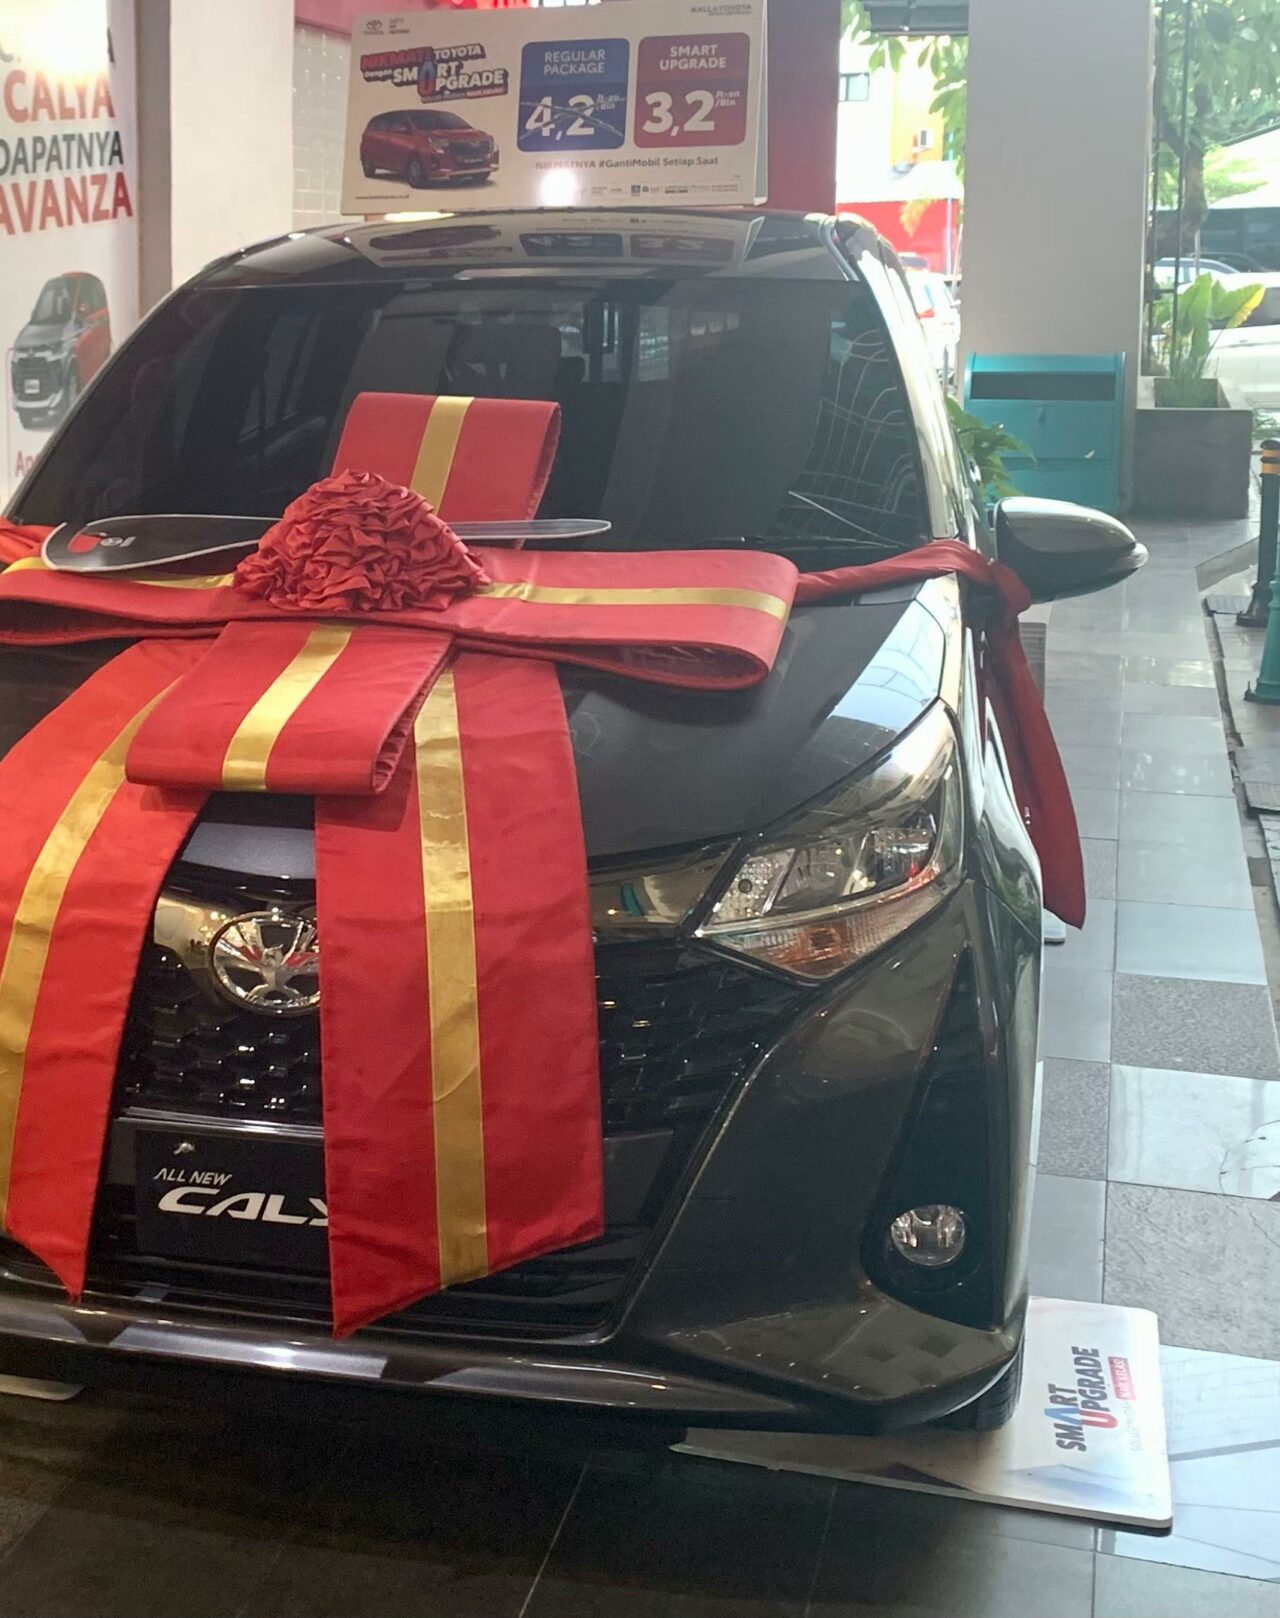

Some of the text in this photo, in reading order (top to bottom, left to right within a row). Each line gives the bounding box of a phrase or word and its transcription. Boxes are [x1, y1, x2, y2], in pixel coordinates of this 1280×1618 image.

[434, 45, 482, 60] TOYOTA
[544, 50, 606, 63] REGULAR
[670, 45, 718, 57] SMART
[543, 62, 606, 76] PACKAGE
[659, 57, 727, 70] UPGRADE
[642, 90, 716, 137] 3,2
[598, 157, 660, 169] #GantiMobil
[663, 157, 695, 169] Setiap
[697, 156, 719, 166] Saat
[153, 1167, 233, 1185] ALL NEW
[158, 1186, 329, 1227] CAL
